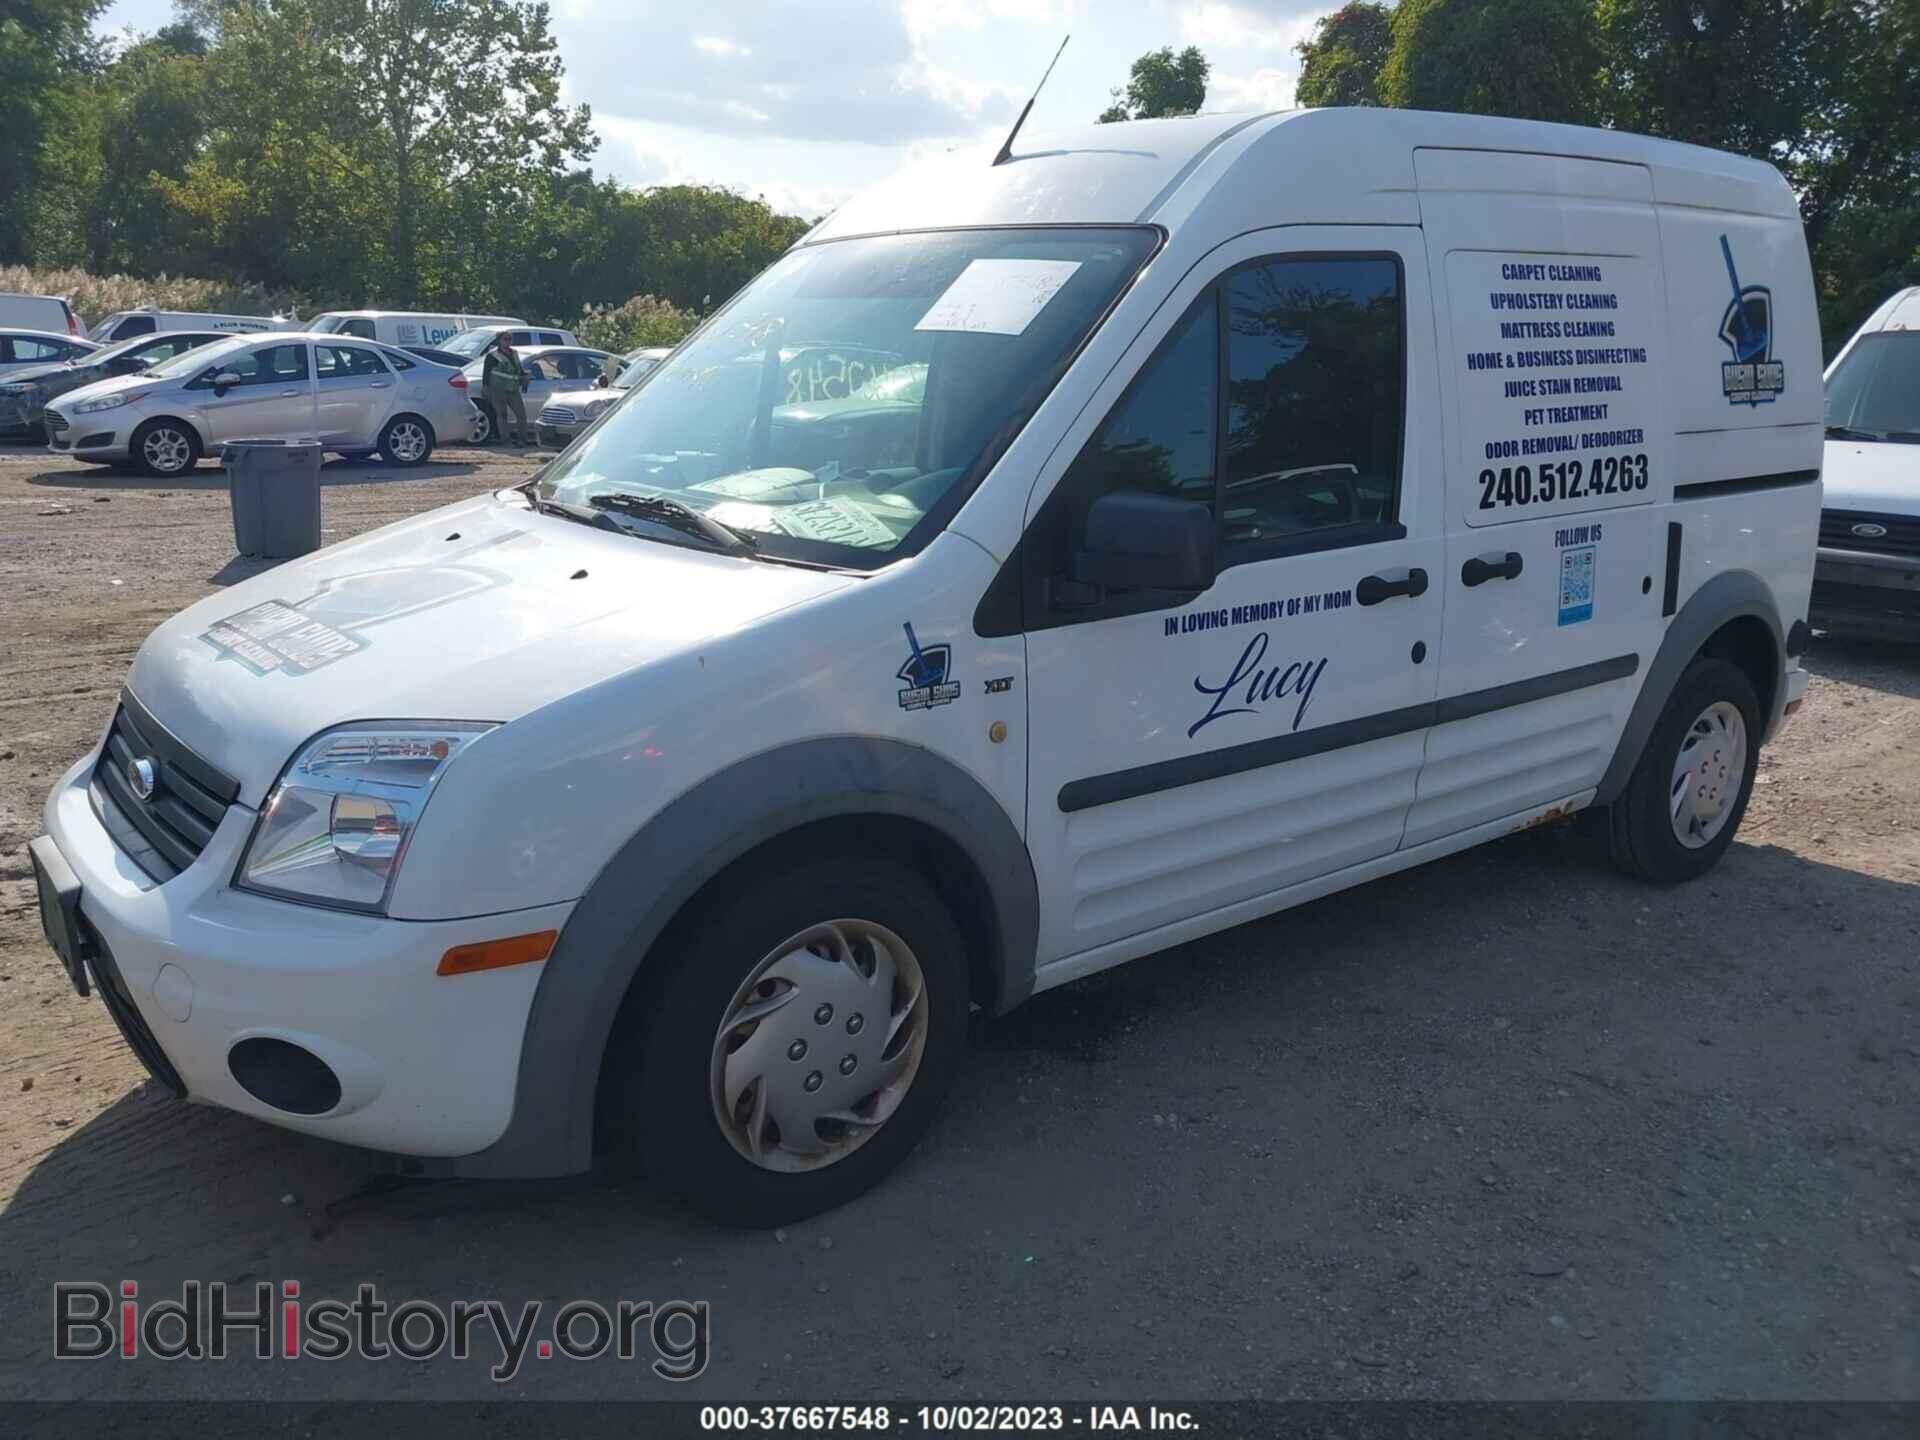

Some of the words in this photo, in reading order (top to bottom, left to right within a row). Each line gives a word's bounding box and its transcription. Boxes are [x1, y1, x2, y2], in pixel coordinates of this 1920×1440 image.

[1502, 264, 1546, 280] CARPET
[1549, 265, 1602, 281] CLEANING
[1490, 293, 1563, 310] UPHOLSTERY
[1566, 294, 1618, 309] CLEANING
[1500, 322, 1561, 339] MATTRESS
[1563, 321, 1615, 337] CLEANING
[1467, 352, 1503, 370] HOME
[1506, 354, 1515, 368] &
[1517, 349, 1574, 367] BUSINESS
[1576, 348, 1647, 365] DISINFECTING
[1504, 380, 1537, 398] JUICE
[1539, 378, 1571, 395] STAIN
[1573, 376, 1623, 393] REMOVAL
[1524, 409, 1545, 426] PET
[1547, 404, 1608, 424] TREATMENT
[1485, 440, 1519, 459] ODOR
[1522, 434, 1579, 455] REMOVAL/
[1581, 429, 1644, 449] DEODORIZER
[1479, 454, 1648, 510] 240.512.4263
[1555, 526, 1589, 548] FOLLOW
[1590, 523, 1602, 542] US
[1164, 617, 1178, 636] IN
[1182, 609, 1228, 633] LOVING
[1232, 600, 1284, 625] MEMORY
[1287, 597, 1301, 616] OF
[1303, 594, 1321, 613] MY
[1323, 590, 1352, 611] MOM
[1188, 632, 1328, 739] Lucy
